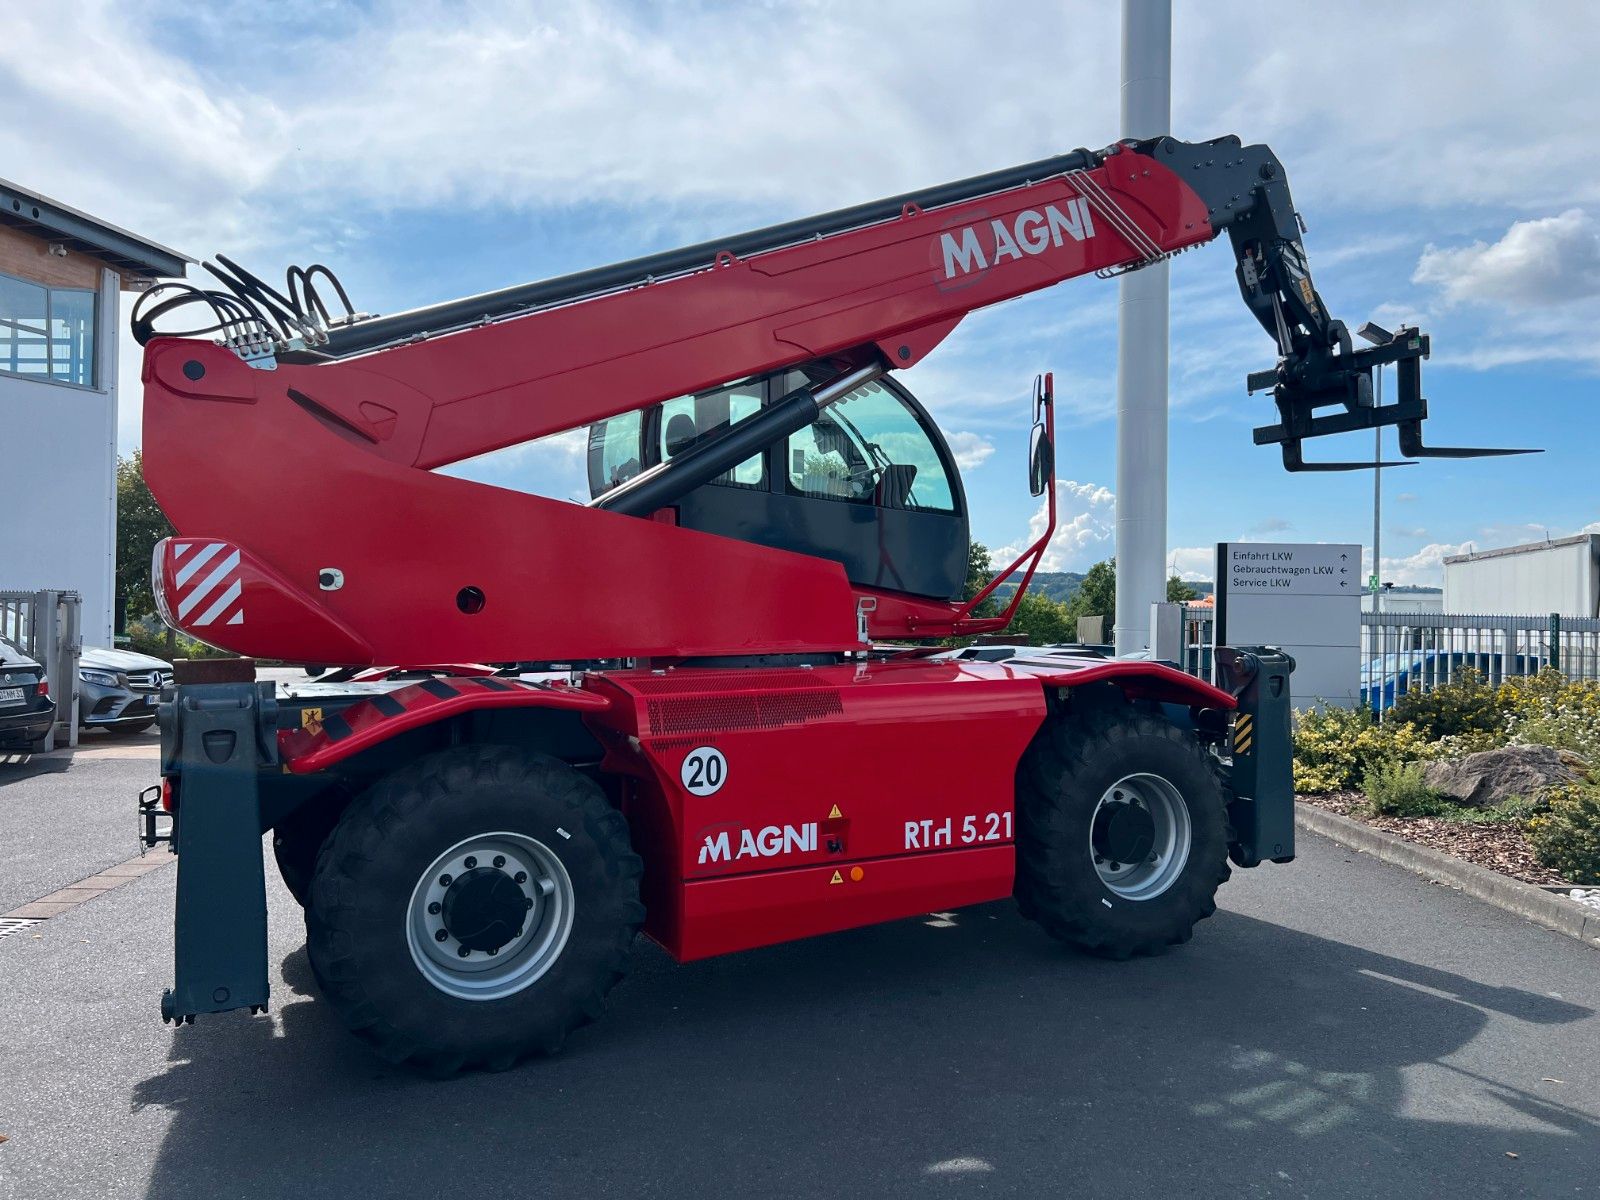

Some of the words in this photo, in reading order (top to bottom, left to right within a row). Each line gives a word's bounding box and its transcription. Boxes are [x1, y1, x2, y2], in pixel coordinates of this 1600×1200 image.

[940, 197, 1095, 279] MAGNI
[1233, 552, 1269, 560] Einfahrt
[1272, 552, 1293, 560] LKW
[1233, 564, 1310, 575] Gebrauchtwagen
[1313, 566, 1334, 575] LKW
[1233, 578, 1267, 586] Service
[1270, 578, 1291, 587] LKW
[688, 755, 721, 788] 20
[961, 811, 1013, 843] 5.21
[698, 822, 818, 865] MAGNI
